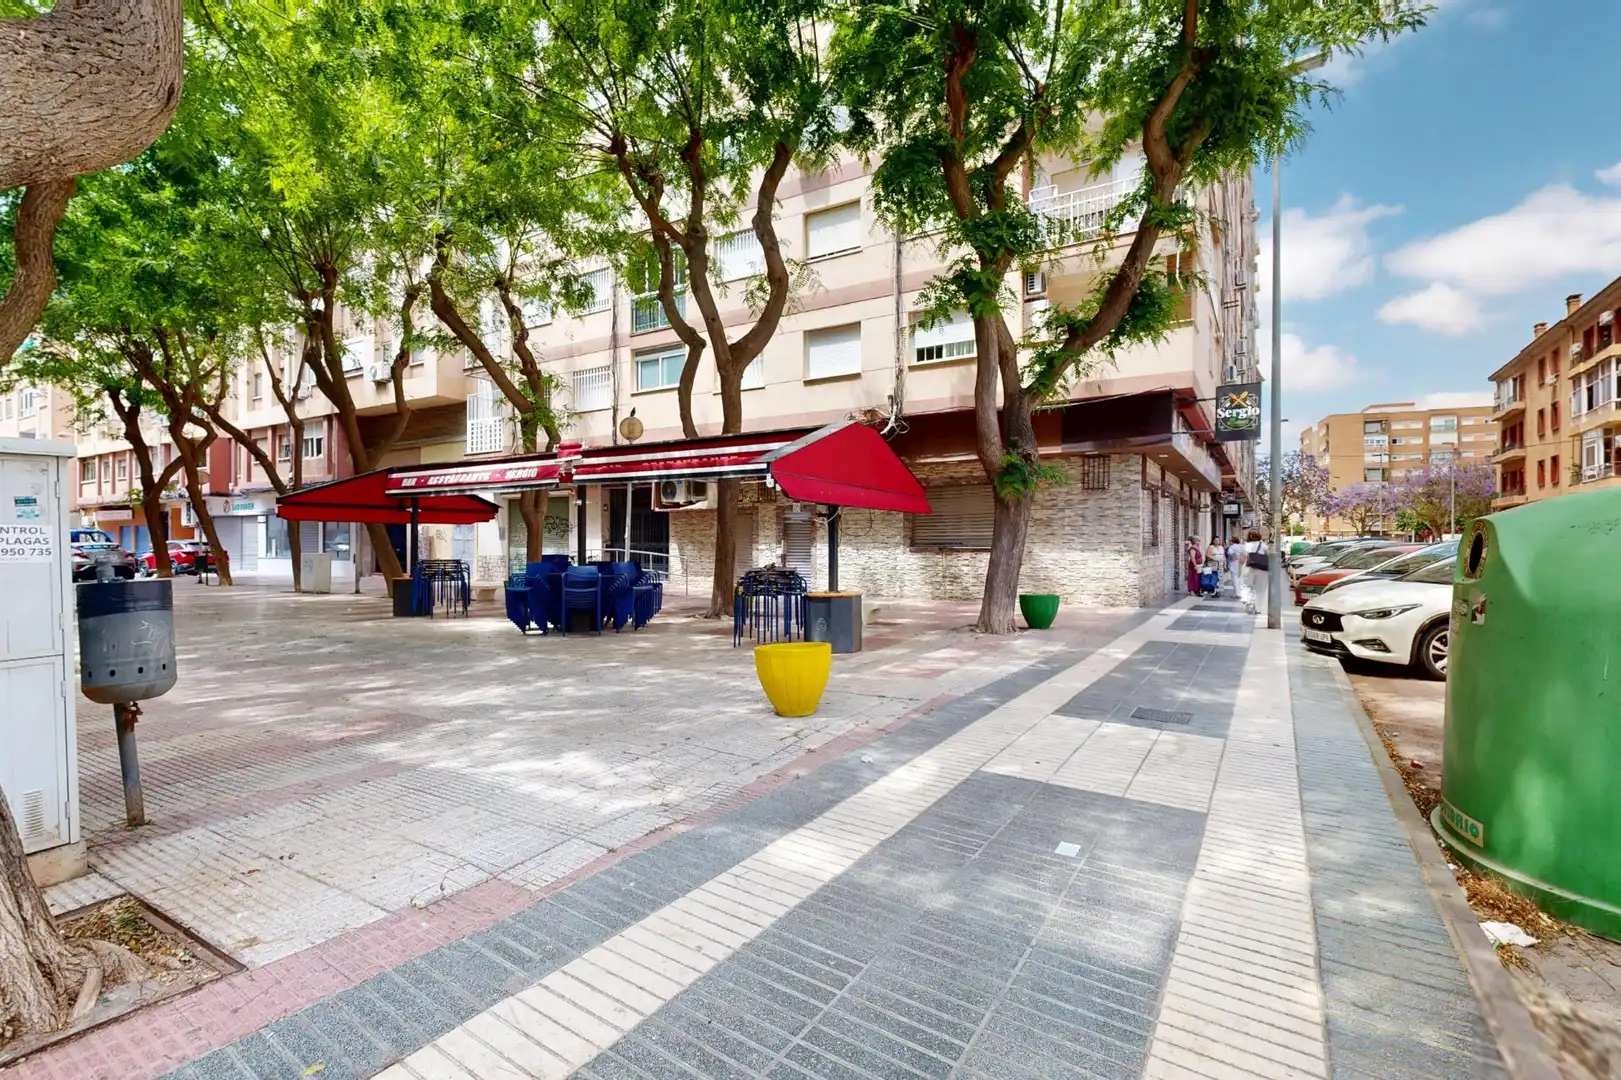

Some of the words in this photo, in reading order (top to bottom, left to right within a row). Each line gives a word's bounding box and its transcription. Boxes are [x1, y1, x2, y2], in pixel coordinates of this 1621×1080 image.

[1217, 406, 1260, 419] Sergio
[1, 548, 25, 556] 950
[29, 548, 52, 556] 735
